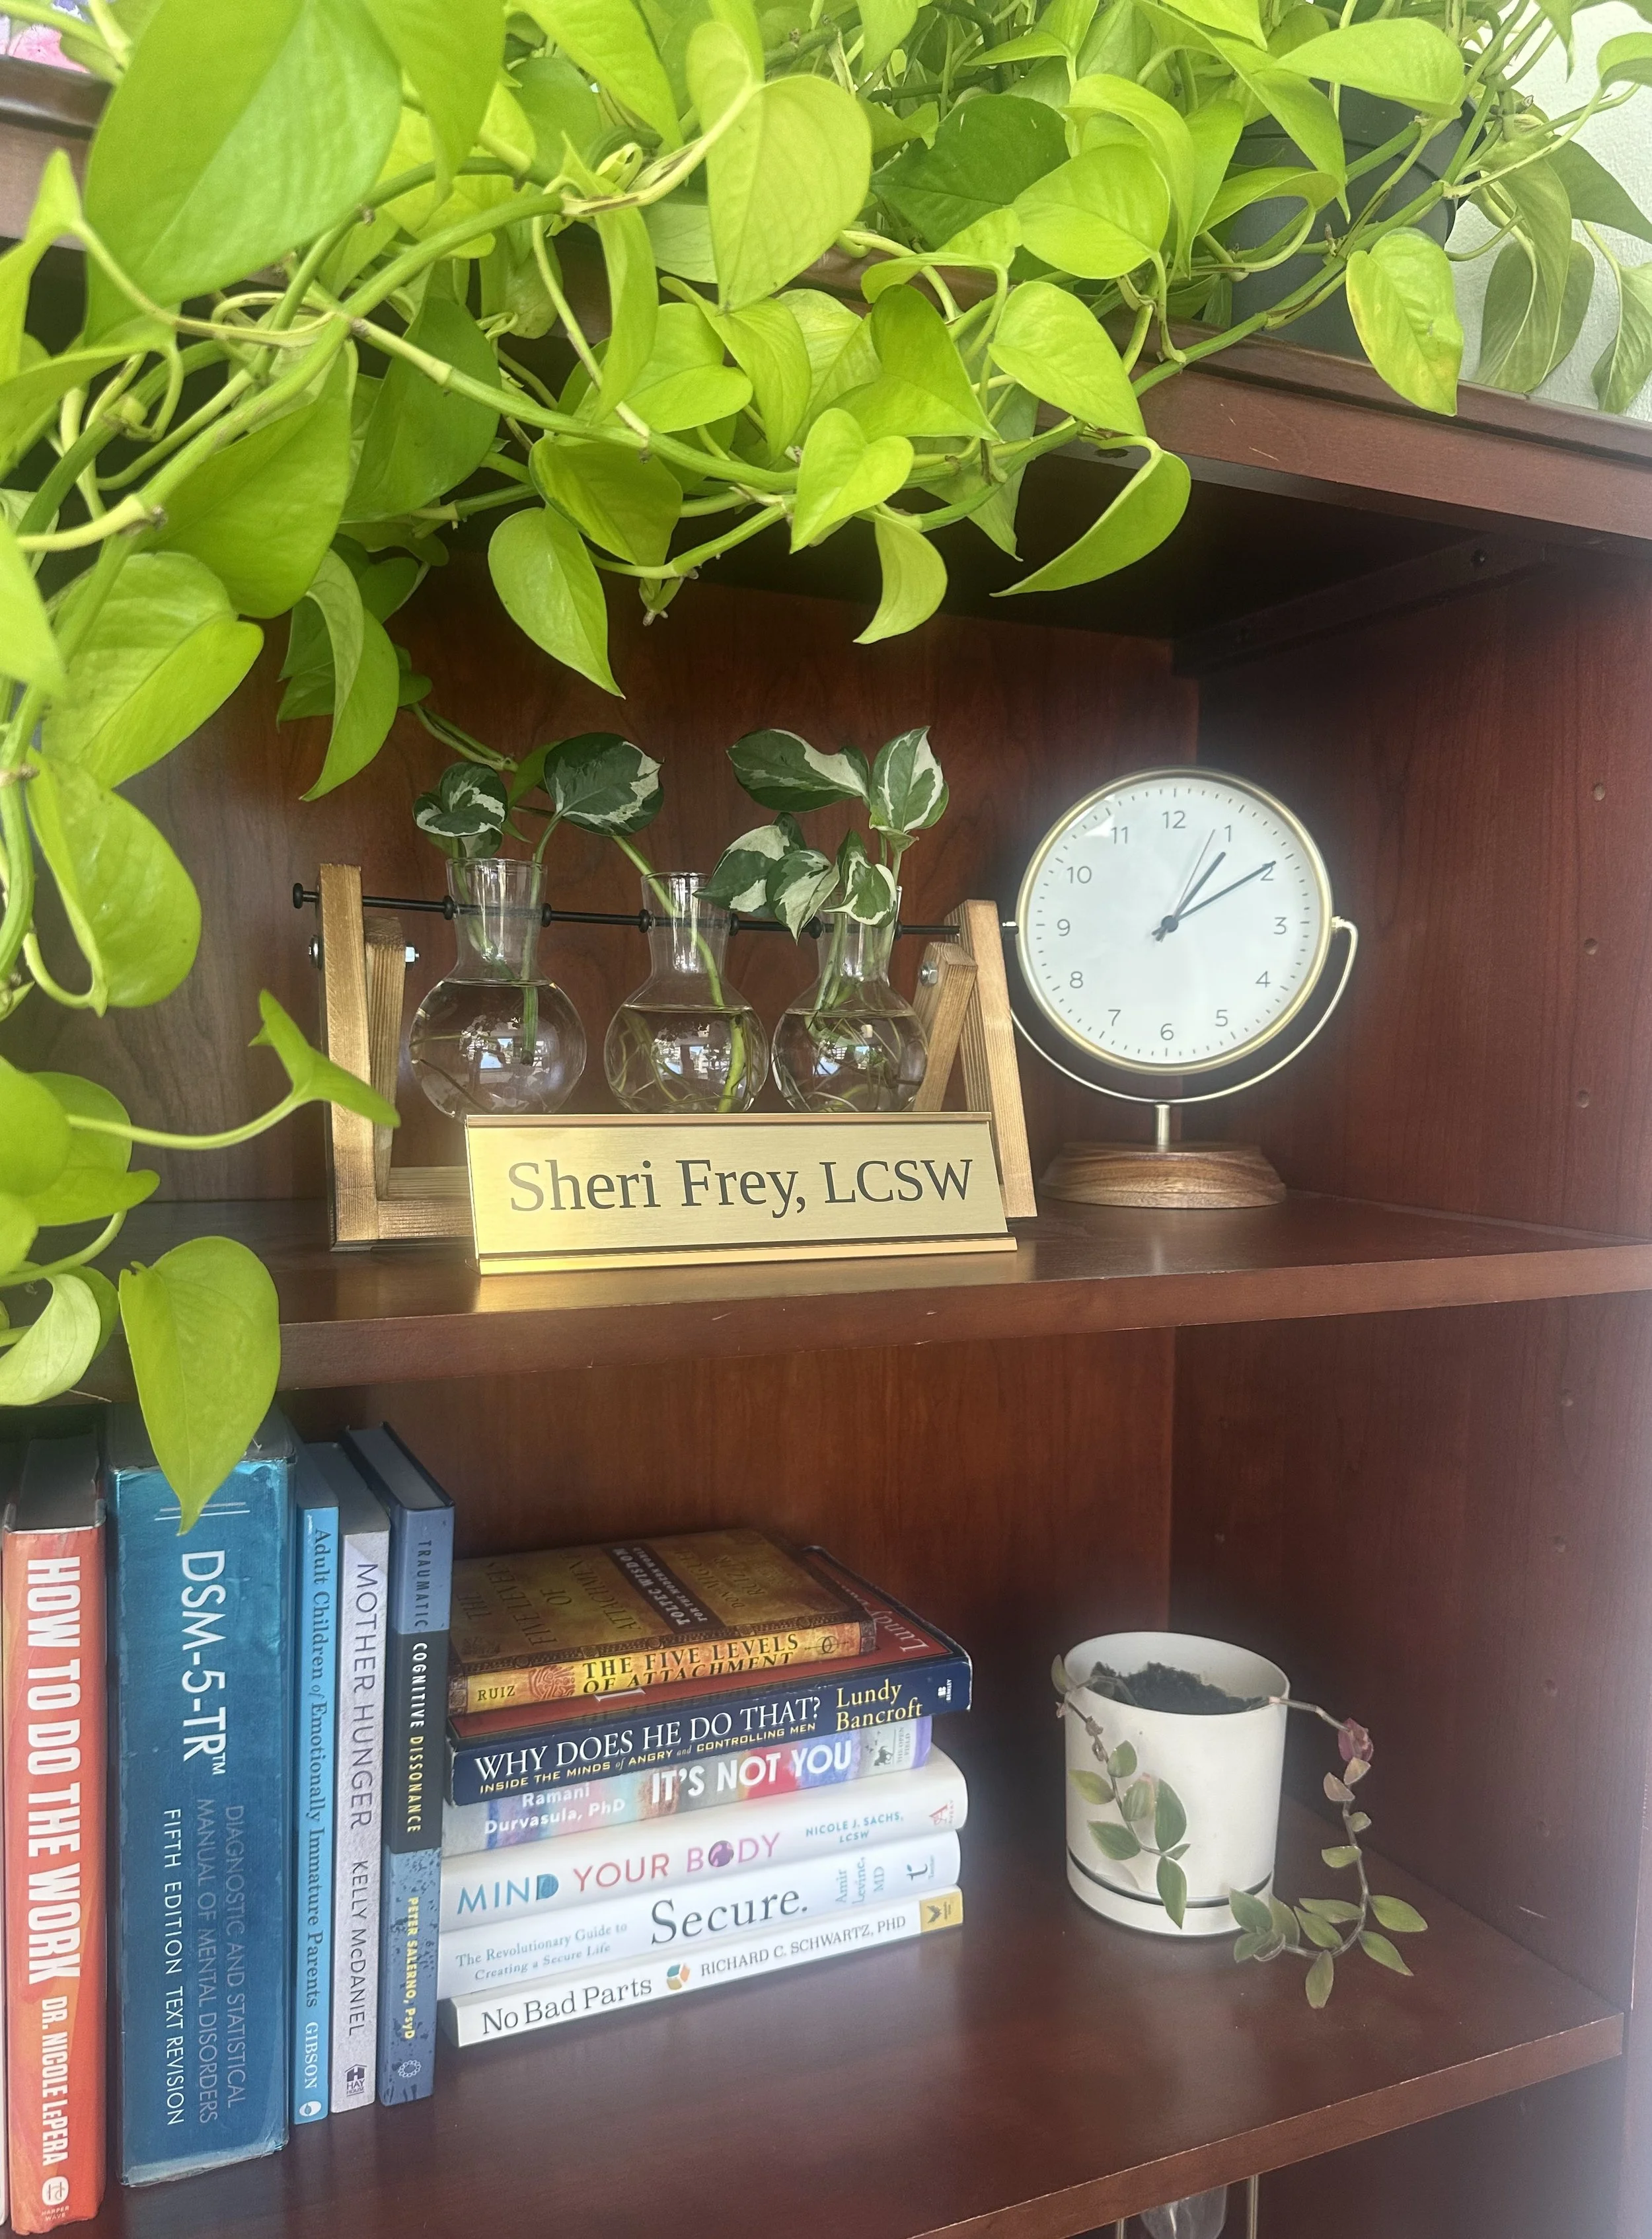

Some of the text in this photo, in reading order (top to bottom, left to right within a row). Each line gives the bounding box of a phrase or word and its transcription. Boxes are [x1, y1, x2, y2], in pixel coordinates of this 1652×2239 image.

[1111, 826, 1128, 844] 11
[1162, 811, 1186, 829] 12
[1224, 825, 1232, 843] 1
[1067, 866, 1092, 884] 10
[1260, 863, 1274, 881] 2
[1057, 919, 1070, 936] 9
[1274, 917, 1287, 934] 3
[1069, 971, 1084, 989] 8
[1256, 971, 1270, 987] 4
[1108, 1010, 1121, 1026] 7
[1160, 1024, 1174, 1040] 6
[1215, 1010, 1228, 1026] 5
[509, 1158, 973, 1218] Sheri Frey, LCSW
[414, 1540, 432, 1627] TRAUMATIC
[541, 1589, 573, 1606] OF
[613, 1548, 691, 1626] TOLTEC WISDOM
[457, 1593, 492, 1619] THE
[689, 1607, 708, 1621] FOR
[513, 1613, 558, 1646] FIVE
[582, 1634, 798, 1679] THE FIVE LEVELS
[582, 1651, 794, 1694] OF ATTACHMENT
[351, 1563, 379, 1830] MOTHER HUNGER
[478, 1685, 515, 1702] RUIZ
[836, 1678, 902, 1708] Lundy
[835, 1697, 923, 1731] Bancroft
[407, 1642, 428, 1833] COGNITIVE DISSONANCE
[475, 1696, 821, 1781] WHY DOES HE DO THAT?
[27, 1556, 81, 1985] HOW TO DO THE WORK
[306, 1529, 332, 2008] Adult Children of Emotionally Immature Parents
[479, 1722, 815, 1795] INSIDE THE MINDS of ANGRY and CONTROLLING MEN
[716, 1753, 781, 1792] NOT
[791, 1740, 852, 1778] YOU
[522, 1782, 590, 1808] Ramani
[484, 1798, 626, 1835] Durvasula, PhD
[806, 1811, 904, 1837] NICOLE J. SACHS,
[839, 1830, 870, 1842] LCSW
[352, 1860, 368, 1919] KELLY
[457, 1832, 780, 1915] MIND YOUR BODY
[835, 1869, 848, 1904] Amir
[874, 1866, 885, 1893] MD
[652, 1890, 807, 1944] Secure.
[197, 1799, 218, 2123] MANUAL OF MENTAL DISORDERS
[225, 1805, 246, 2108] DIAGNOSTIC AND STATISTICAL
[455, 1922, 628, 1968] The Revolutionary Guide to
[475, 1961, 529, 1981] Creating
[543, 1950, 582, 1967] Secure
[587, 1943, 611, 1956] Life
[701, 1916, 906, 1977] RICHARD C. SCHWARTZ, PHD
[164, 1808, 184, 2125] FIFTH EDITION TEXT REVISION
[402, 1897, 419, 2039] PETER SALERNO, PsyD
[42, 1995, 67, 2030] DR.
[481, 1978, 652, 2035] No Bad Parts
[42, 2031, 68, 2098] NICOLE
[304, 2022, 319, 2089] GIBSON
[347, 2078, 365, 2090] HAY
